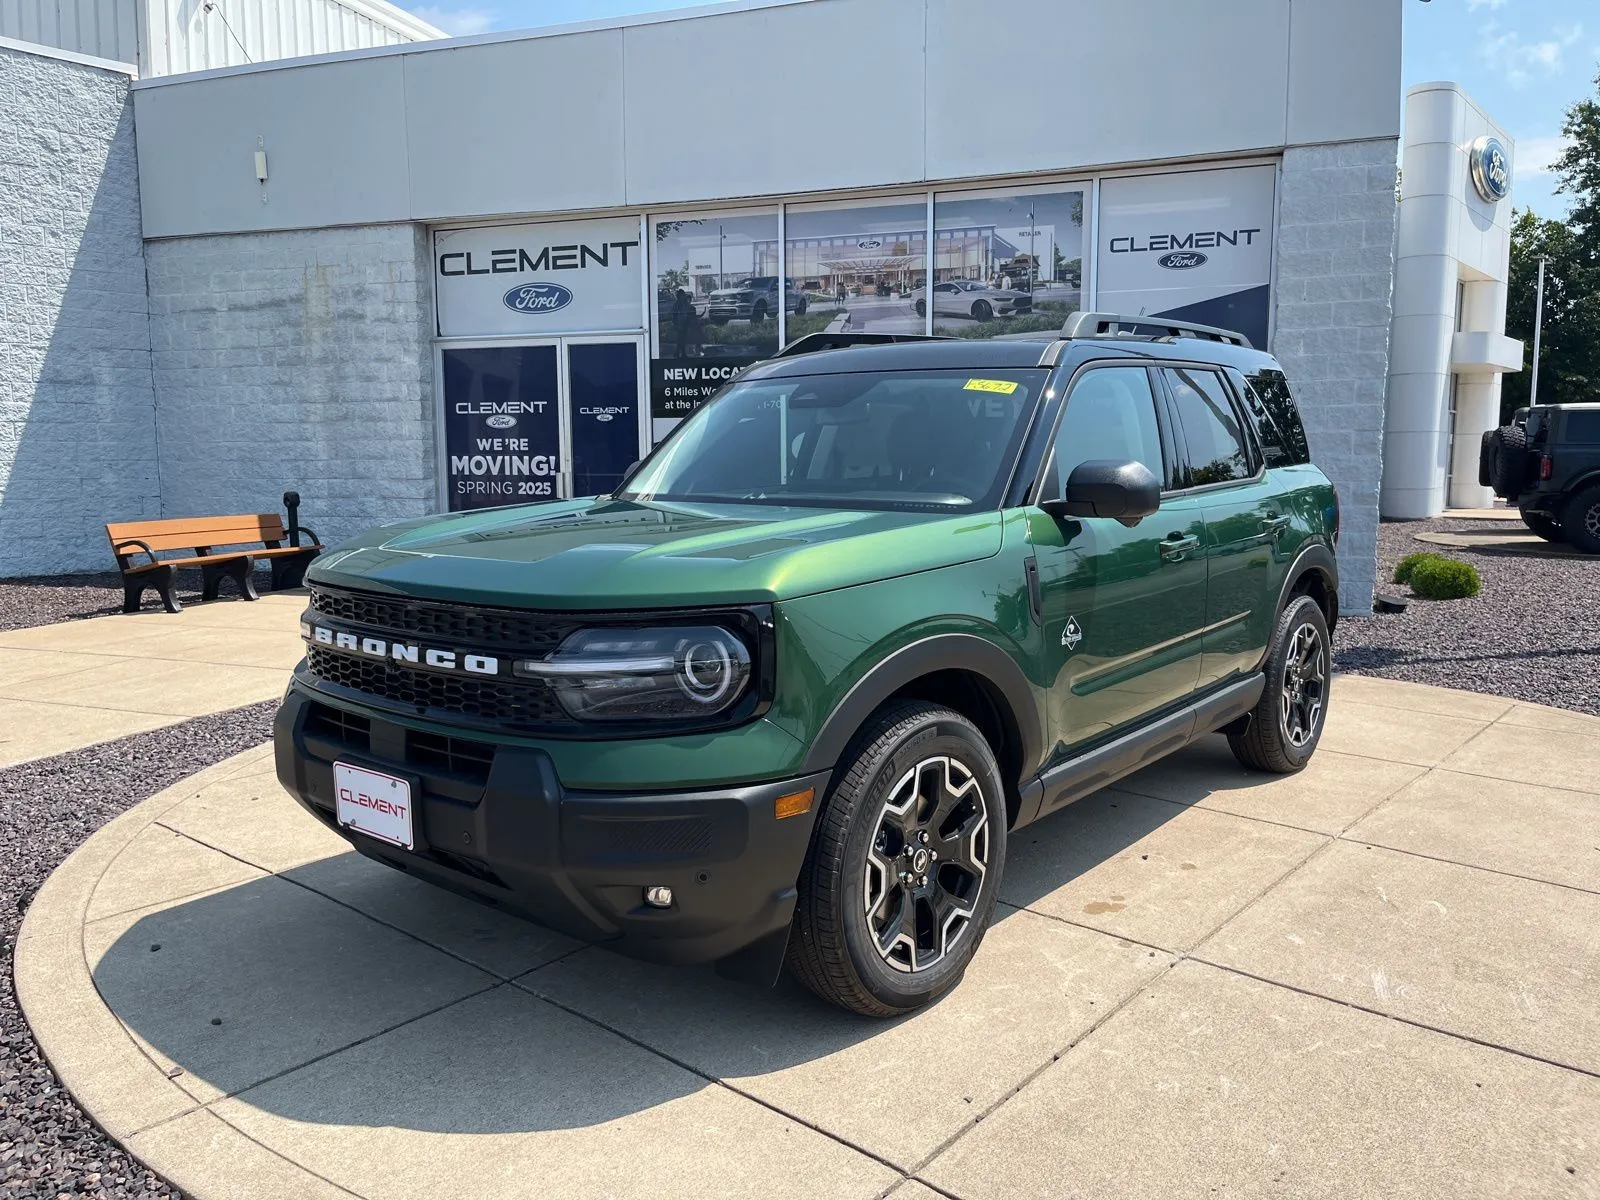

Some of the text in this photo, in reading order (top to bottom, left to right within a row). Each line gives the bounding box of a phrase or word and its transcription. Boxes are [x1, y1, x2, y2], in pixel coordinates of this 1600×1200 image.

[1489, 148, 1508, 188] Ford
[1109, 228, 1261, 254] CLEMENT
[440, 240, 639, 277] CLEMENT
[1166, 253, 1199, 268] Ford
[513, 286, 560, 310] Ford
[663, 366, 746, 381] NEW LOCA
[664, 387, 671, 397] 6
[673, 386, 699, 396] Miles
[455, 401, 548, 414] CLEMENT
[579, 406, 630, 414] CLEMENT
[664, 400, 674, 409] at
[676, 400, 691, 409] the
[491, 416, 511, 428] Ford
[476, 438, 529, 451] WE'RE
[451, 455, 556, 476] MOVING!
[457, 481, 552, 496] SPRING 2025
[314, 626, 499, 676] BRONCO
[340, 788, 407, 820] CLEMENT
